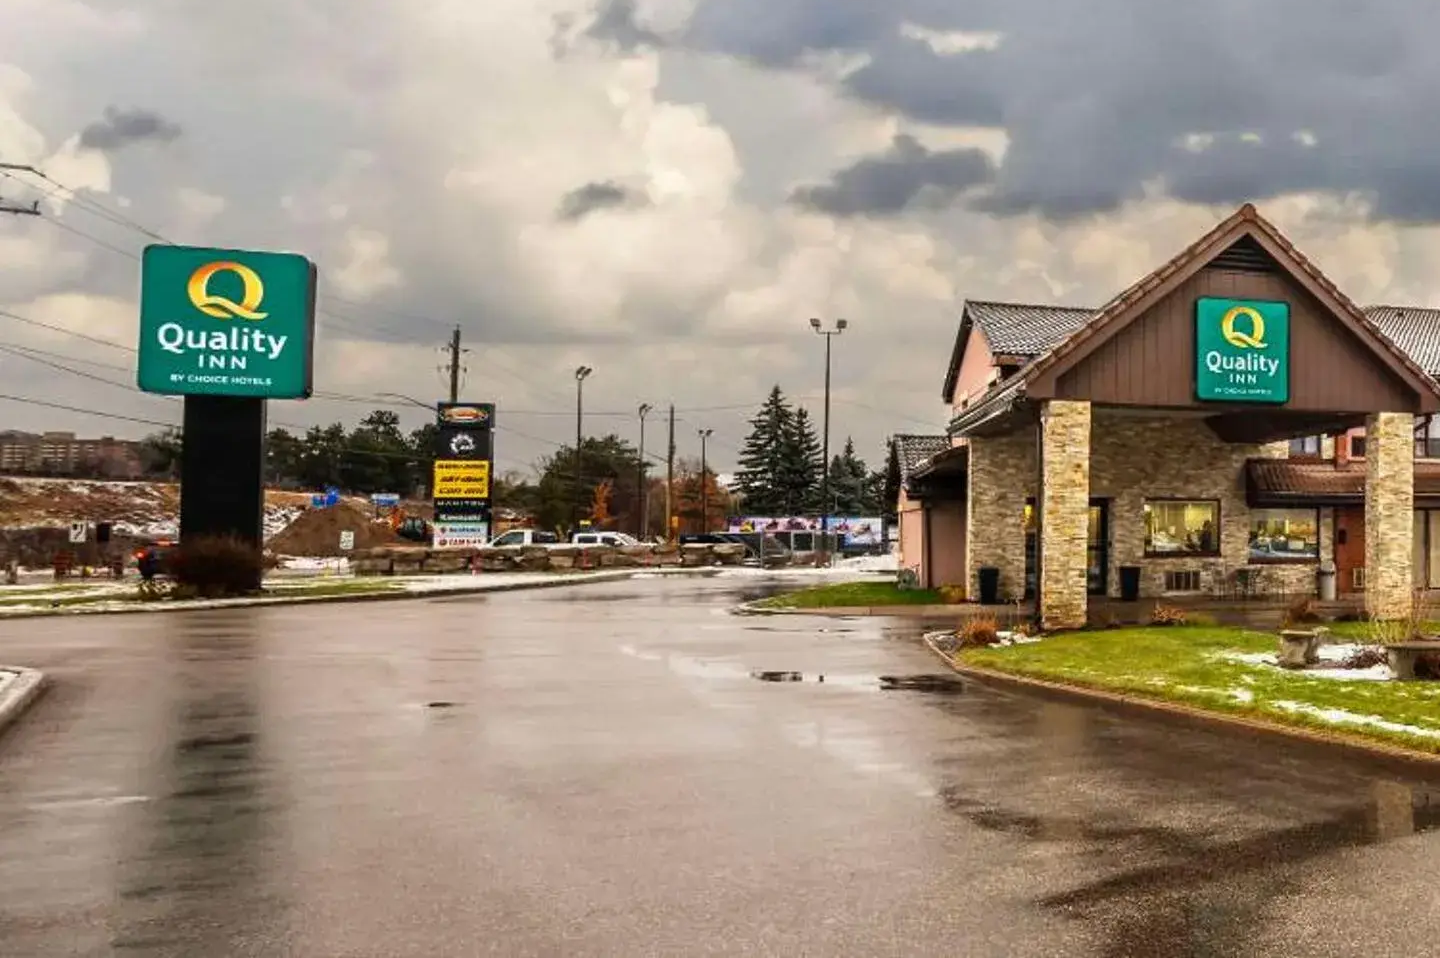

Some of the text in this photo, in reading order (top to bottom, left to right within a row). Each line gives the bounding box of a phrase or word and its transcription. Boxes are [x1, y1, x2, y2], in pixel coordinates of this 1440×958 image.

[187, 261, 269, 320] Q
[157, 321, 288, 360] Quality
[1222, 306, 1268, 349] Q
[198, 354, 247, 370] INN
[1206, 350, 1279, 377] Quality
[170, 373, 272, 386] BY CHOICE HOTELS
[1229, 373, 1257, 384] INN
